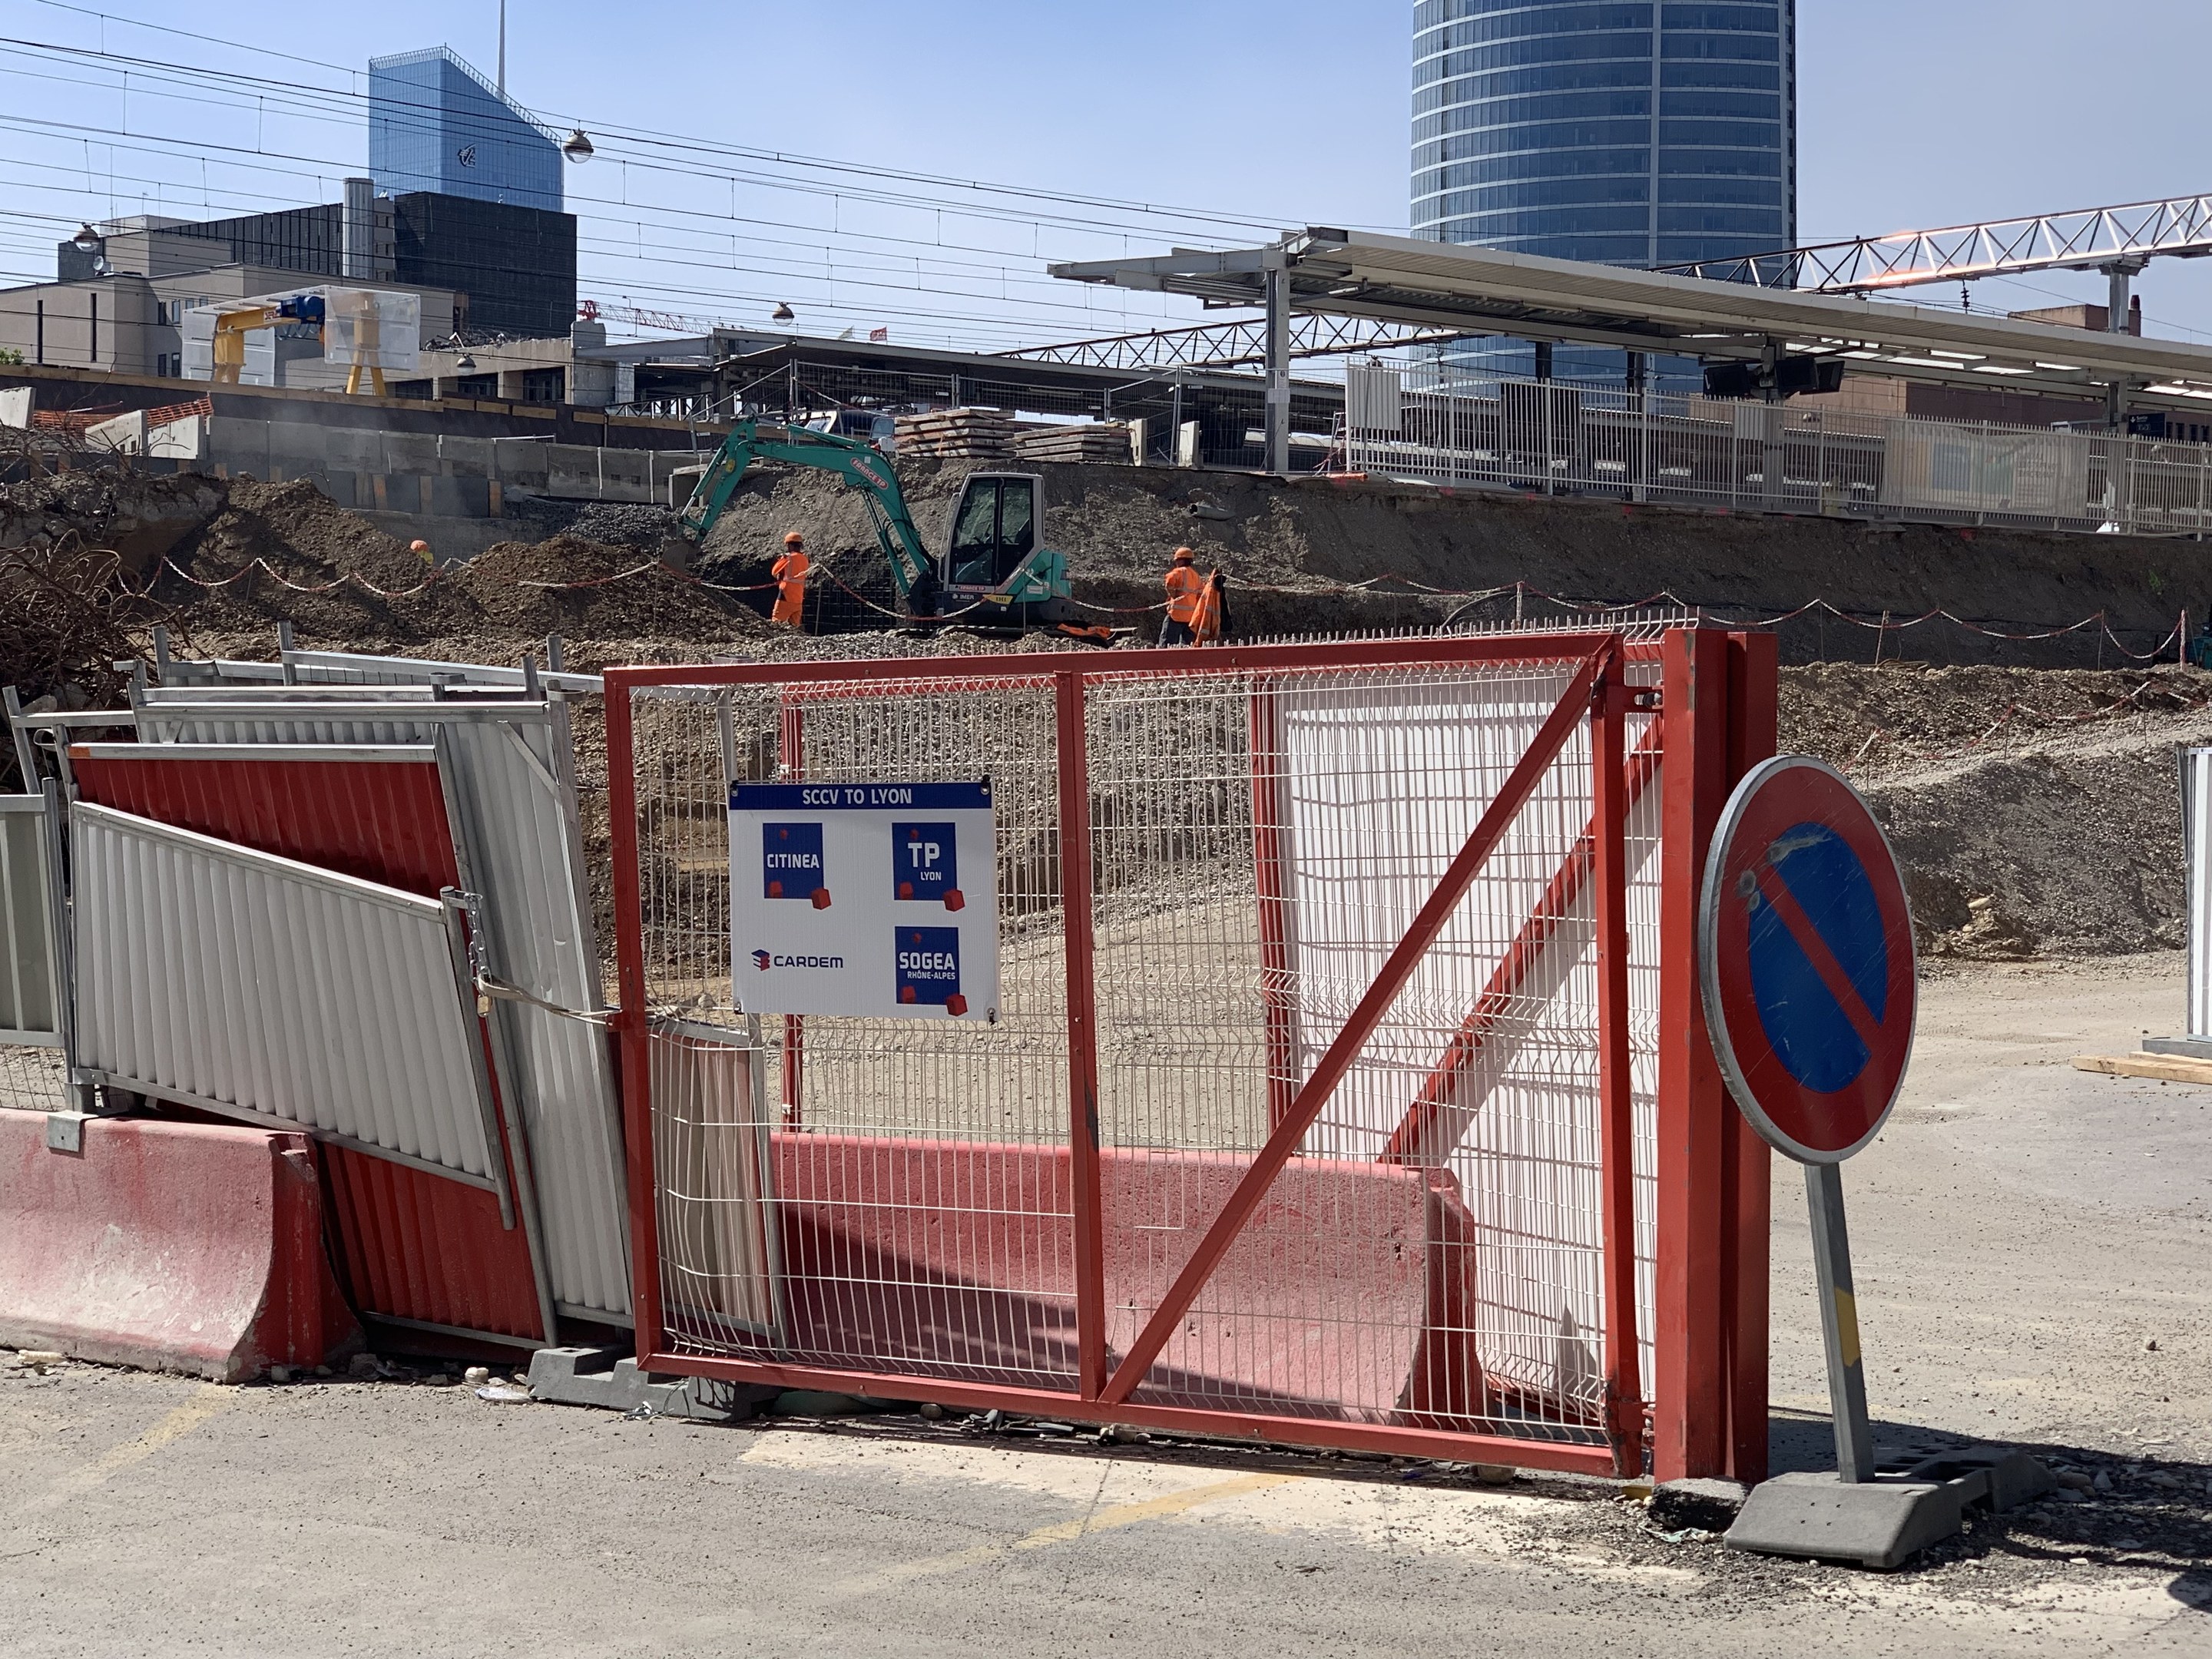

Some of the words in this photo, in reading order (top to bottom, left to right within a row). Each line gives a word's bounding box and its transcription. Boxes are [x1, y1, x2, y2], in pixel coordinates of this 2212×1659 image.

[853, 459, 877, 480] FRANCE
[876, 478, 886, 487] TP
[803, 789, 839, 804] SCCV
[845, 789, 865, 804] TO
[871, 788, 912, 804] LYON
[767, 854, 820, 869] CITINEA
[907, 843, 940, 868] TP
[920, 871, 942, 881] LYON
[773, 955, 843, 969] CARDEM
[899, 952, 955, 970] SOGEA
